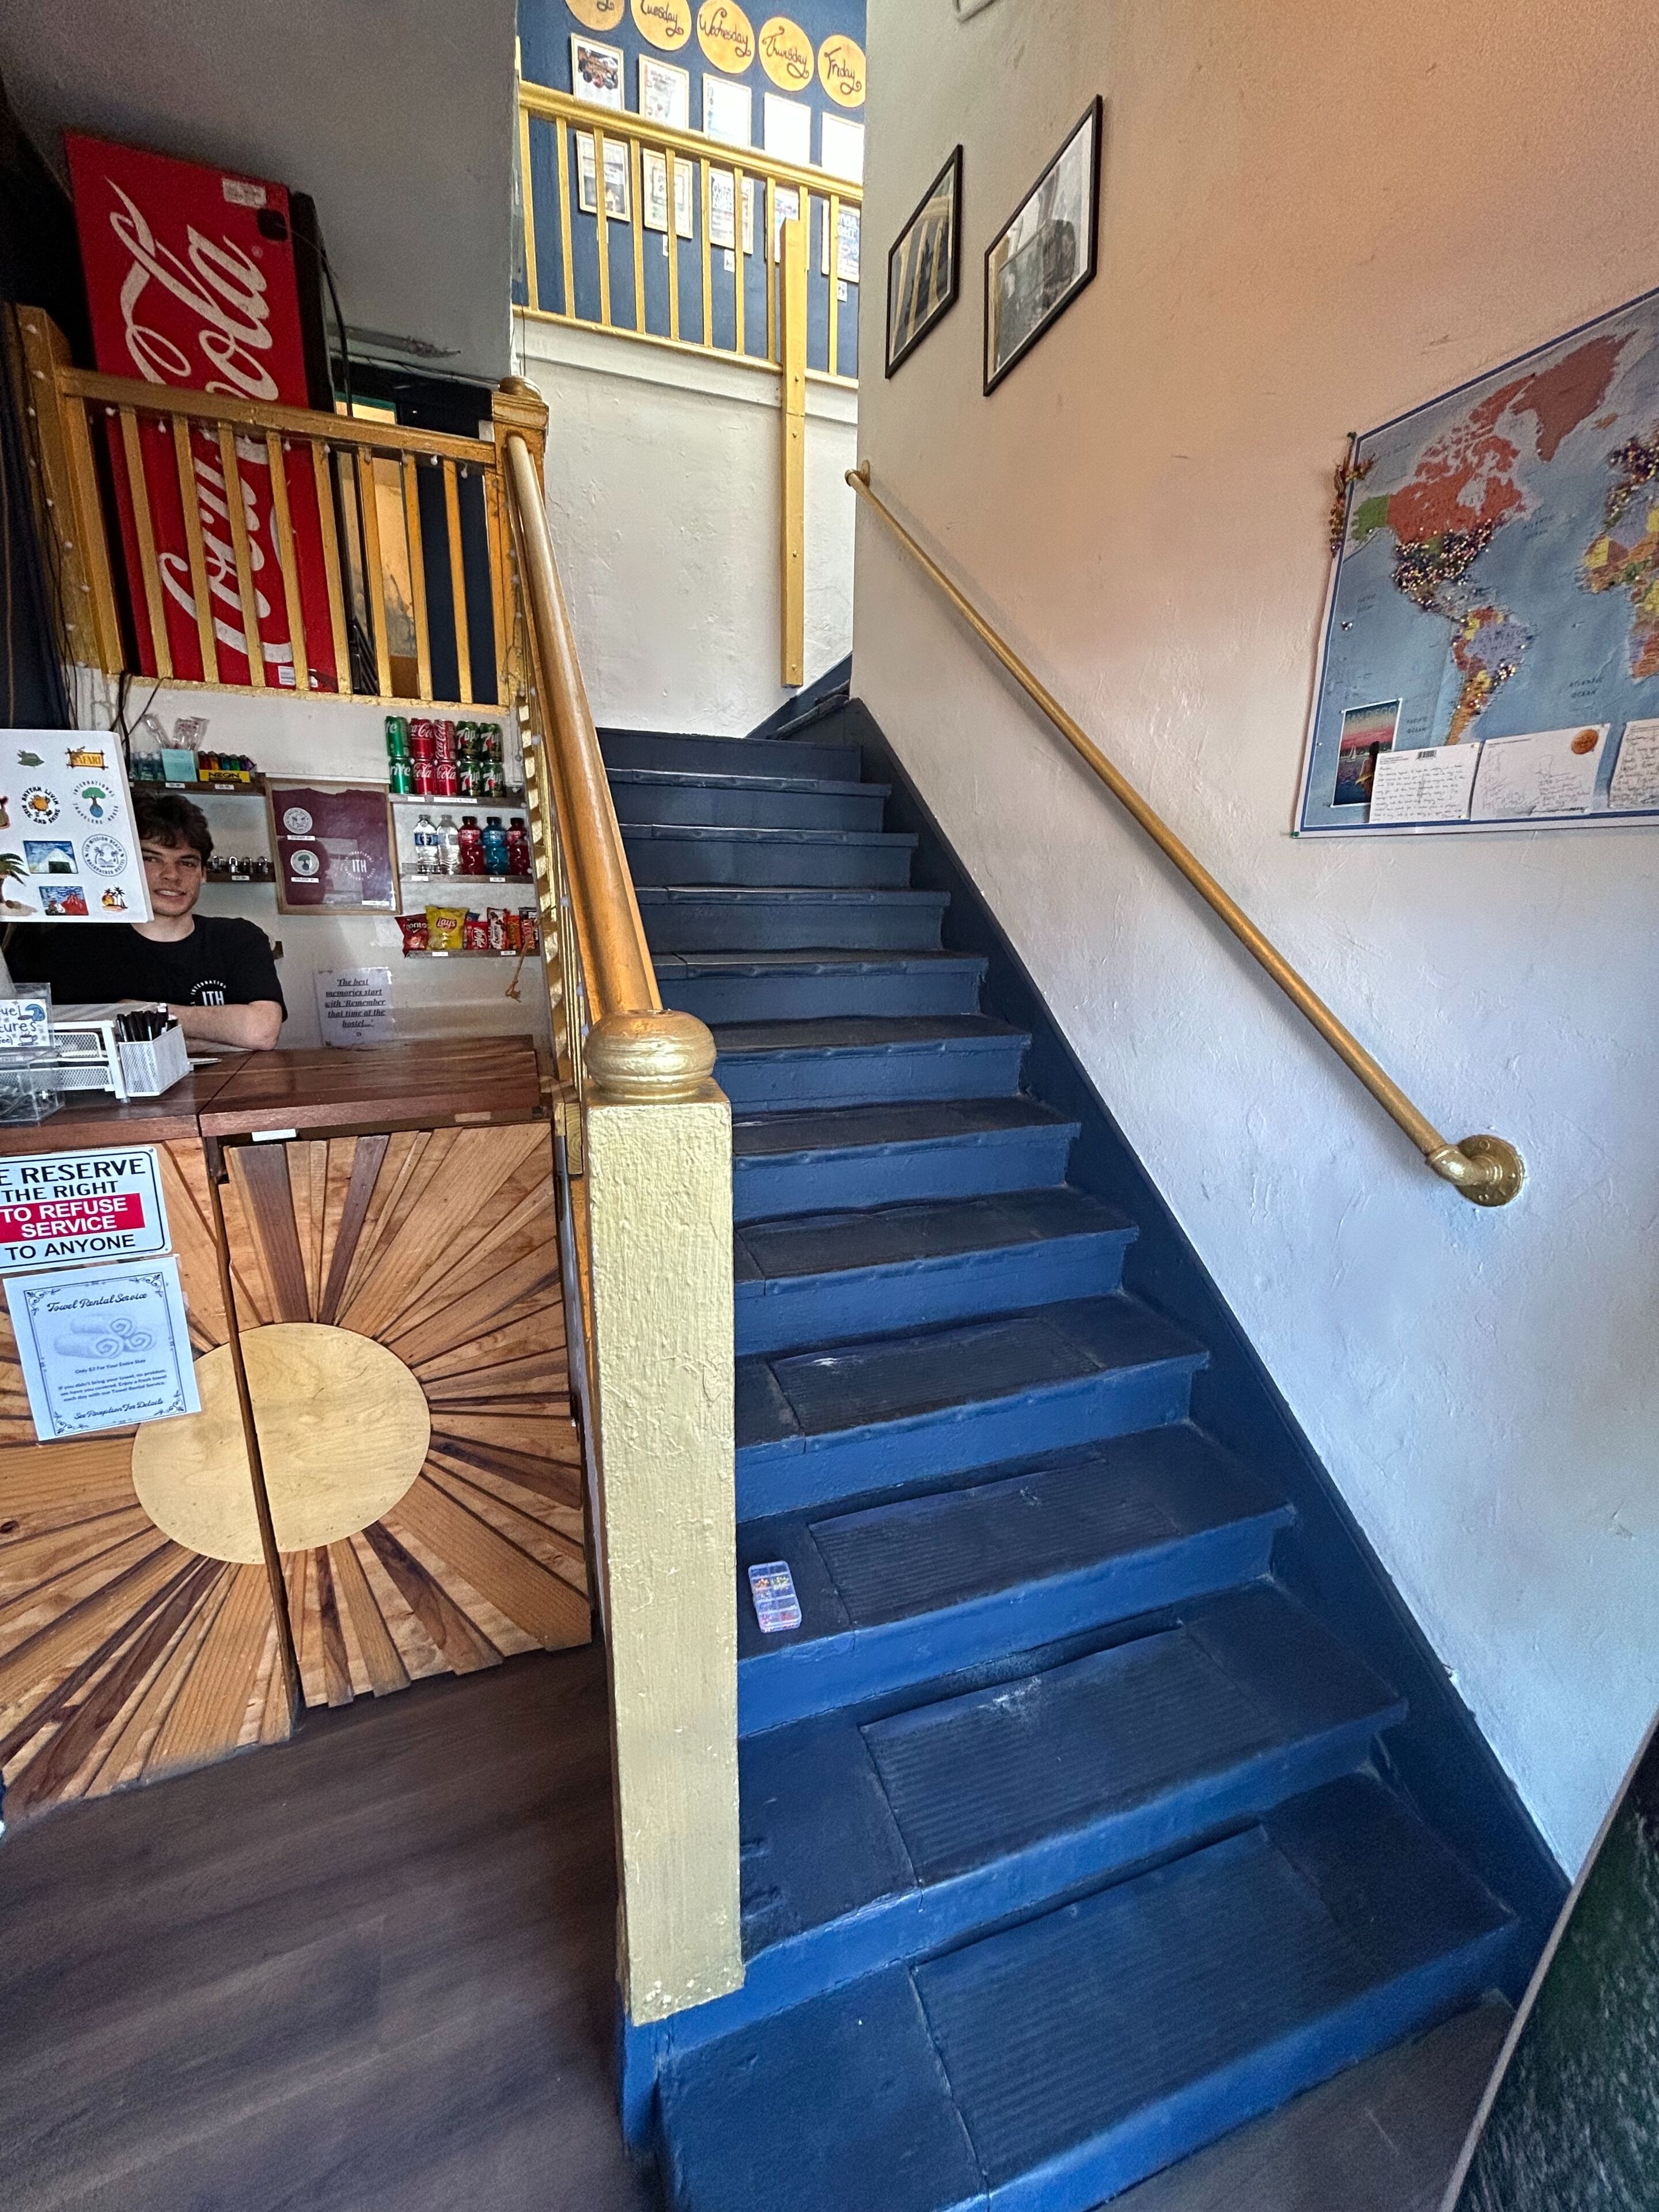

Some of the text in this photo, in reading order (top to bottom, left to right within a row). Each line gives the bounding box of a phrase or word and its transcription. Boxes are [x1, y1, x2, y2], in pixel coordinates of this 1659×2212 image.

[698, 7, 751, 58] Wednesday
[762, 25, 809, 79] Thursday
[824, 47, 862, 95] Friday
[48, 808, 60, 824] SHINE
[352, 859, 367, 873] ITH
[202, 991, 225, 1006] ITH
[325, 989, 362, 997] memories
[0, 1005, 21, 1016] uel
[328, 1010, 343, 1018] that
[346, 1010, 362, 1018] time
[373, 1009, 386, 1017] the
[0, 1158, 146, 1185] E RESERVE
[1, 1180, 119, 1203] THE RIGHT
[1, 1197, 128, 1223] TO REFUSE
[21, 1215, 117, 1238] SERVICE
[5, 1234, 136, 1260] TO ANYONE
[47, 1292, 147, 1313] Towel Rental Service
[74, 1412, 86, 1420] See
[86, 1407, 123, 1418] Reception
[137, 1398, 164, 1409] Details
